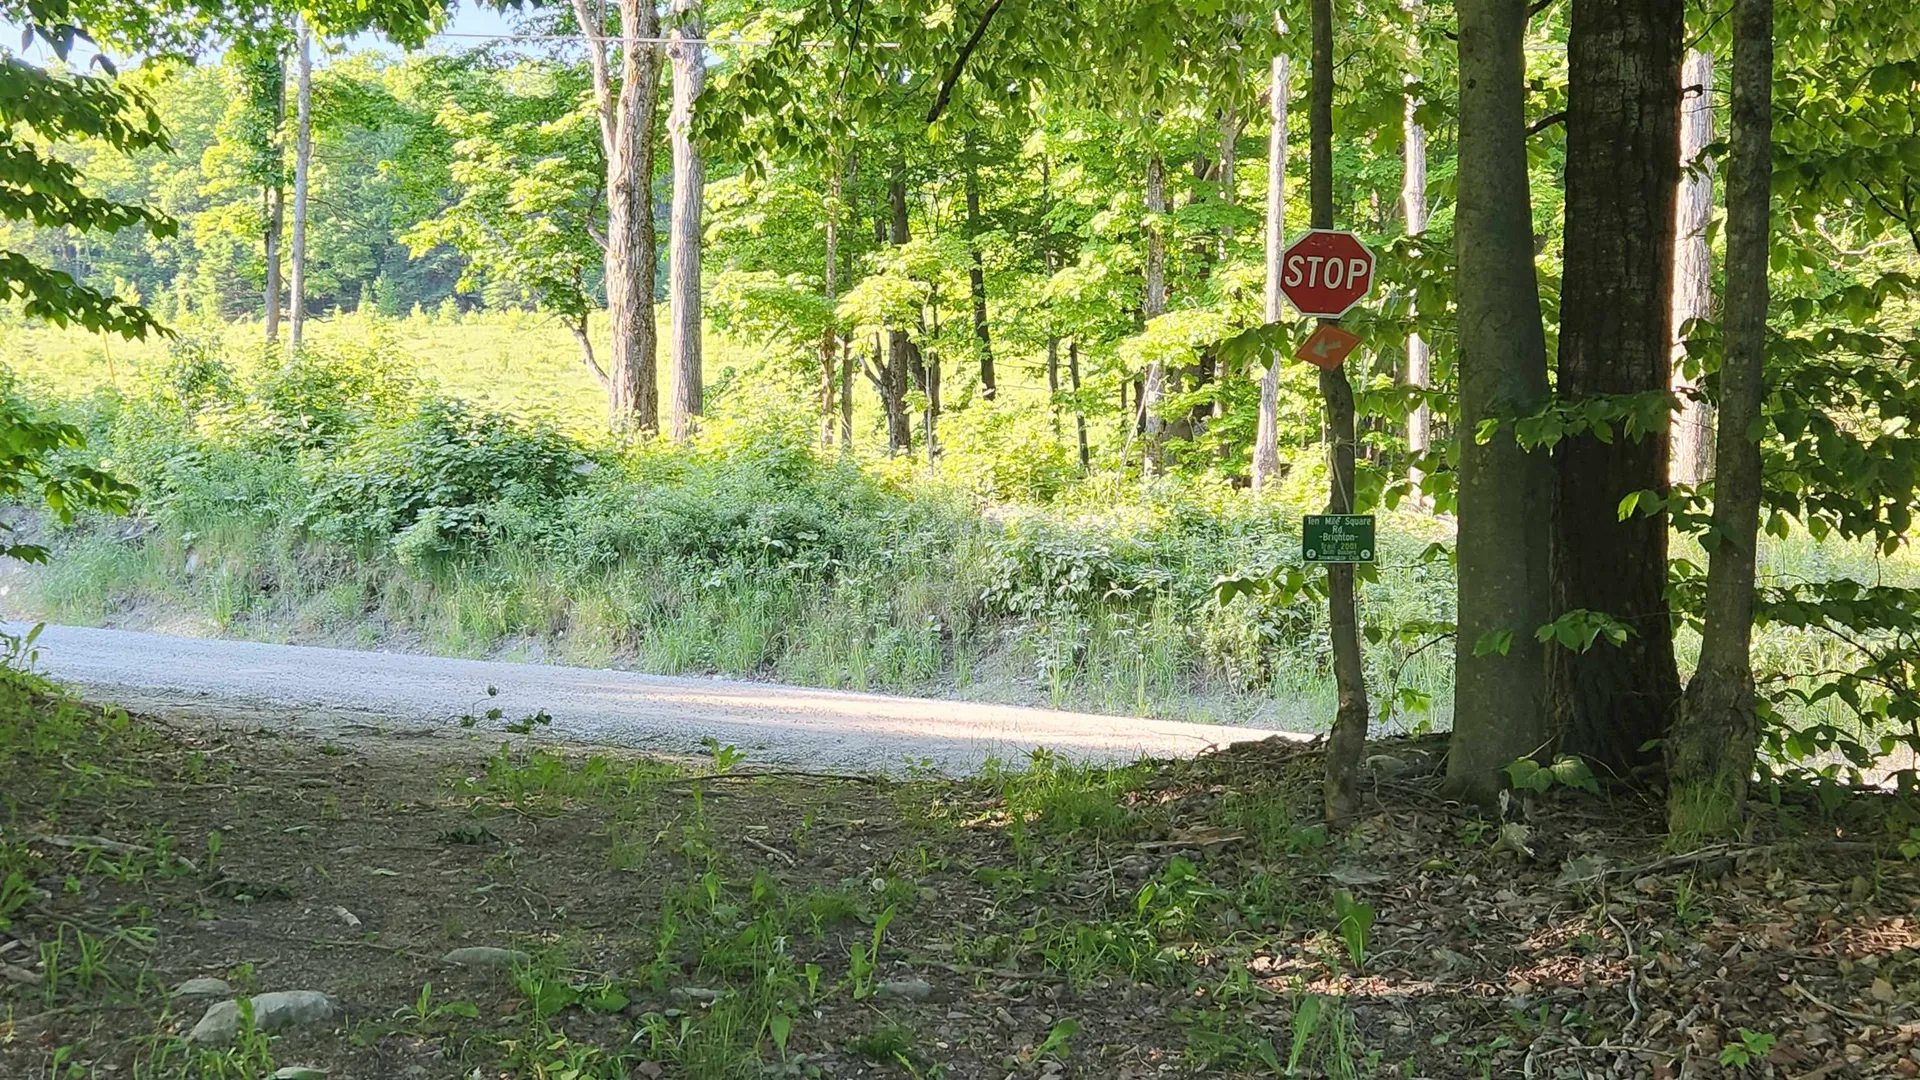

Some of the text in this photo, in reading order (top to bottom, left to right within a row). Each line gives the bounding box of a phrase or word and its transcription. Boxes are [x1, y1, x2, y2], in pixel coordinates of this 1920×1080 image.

[1284, 255, 1368, 289] STOP
[1307, 517, 1371, 527] Ten Mile Square
